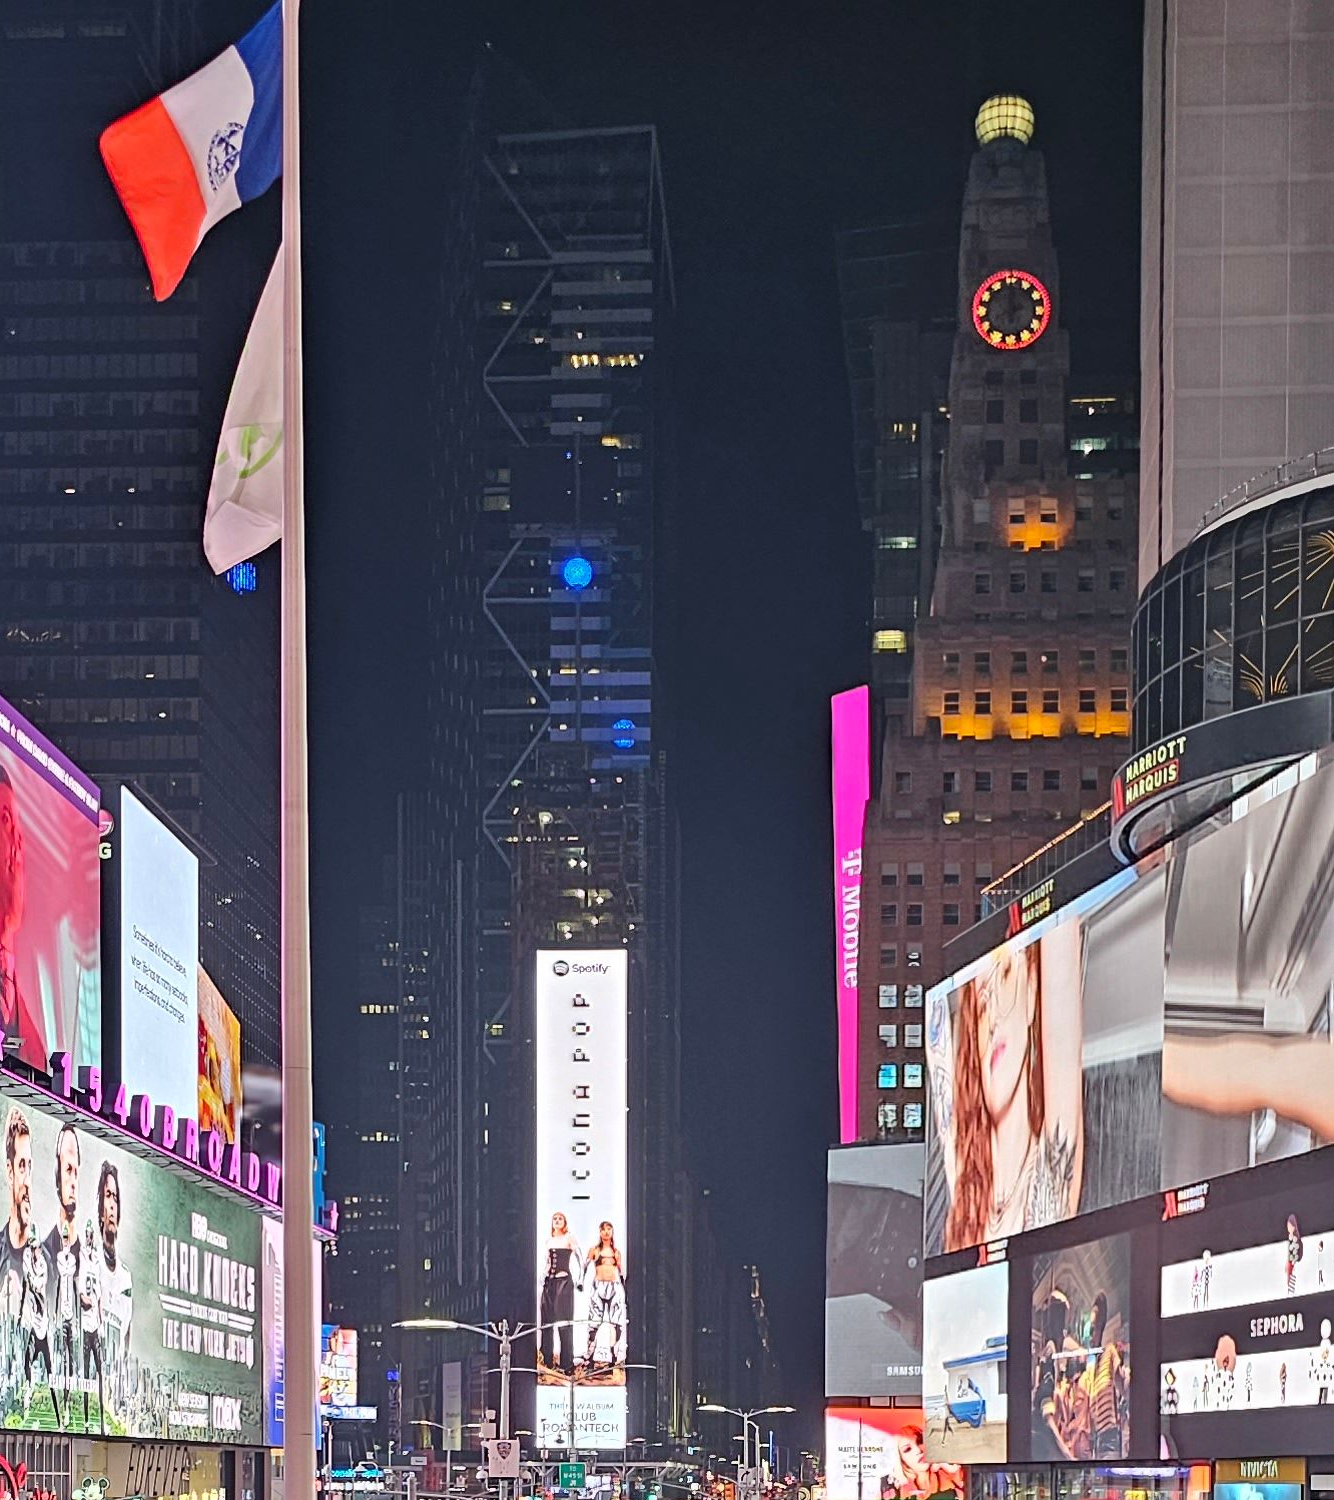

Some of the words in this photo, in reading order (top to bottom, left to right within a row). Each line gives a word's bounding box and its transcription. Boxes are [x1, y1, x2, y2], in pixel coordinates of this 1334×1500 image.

[1125, 735, 1187, 783] MARRIOTT
[1125, 763, 1178, 806] MARQUIS
[571, 963, 609, 975] Spotify
[58, 1050, 153, 1138] 1540
[157, 1234, 200, 1296] HARD
[202, 1250, 256, 1313] KNOCKS
[162, 1317, 180, 1350] THE
[181, 1322, 202, 1355] NEW
[202, 1327, 226, 1359] YORK
[1250, 1313, 1304, 1338] SEPHORA
[886, 1366, 923, 1377] SAMSU
[1240, 1459, 1279, 1479] INVICTA
